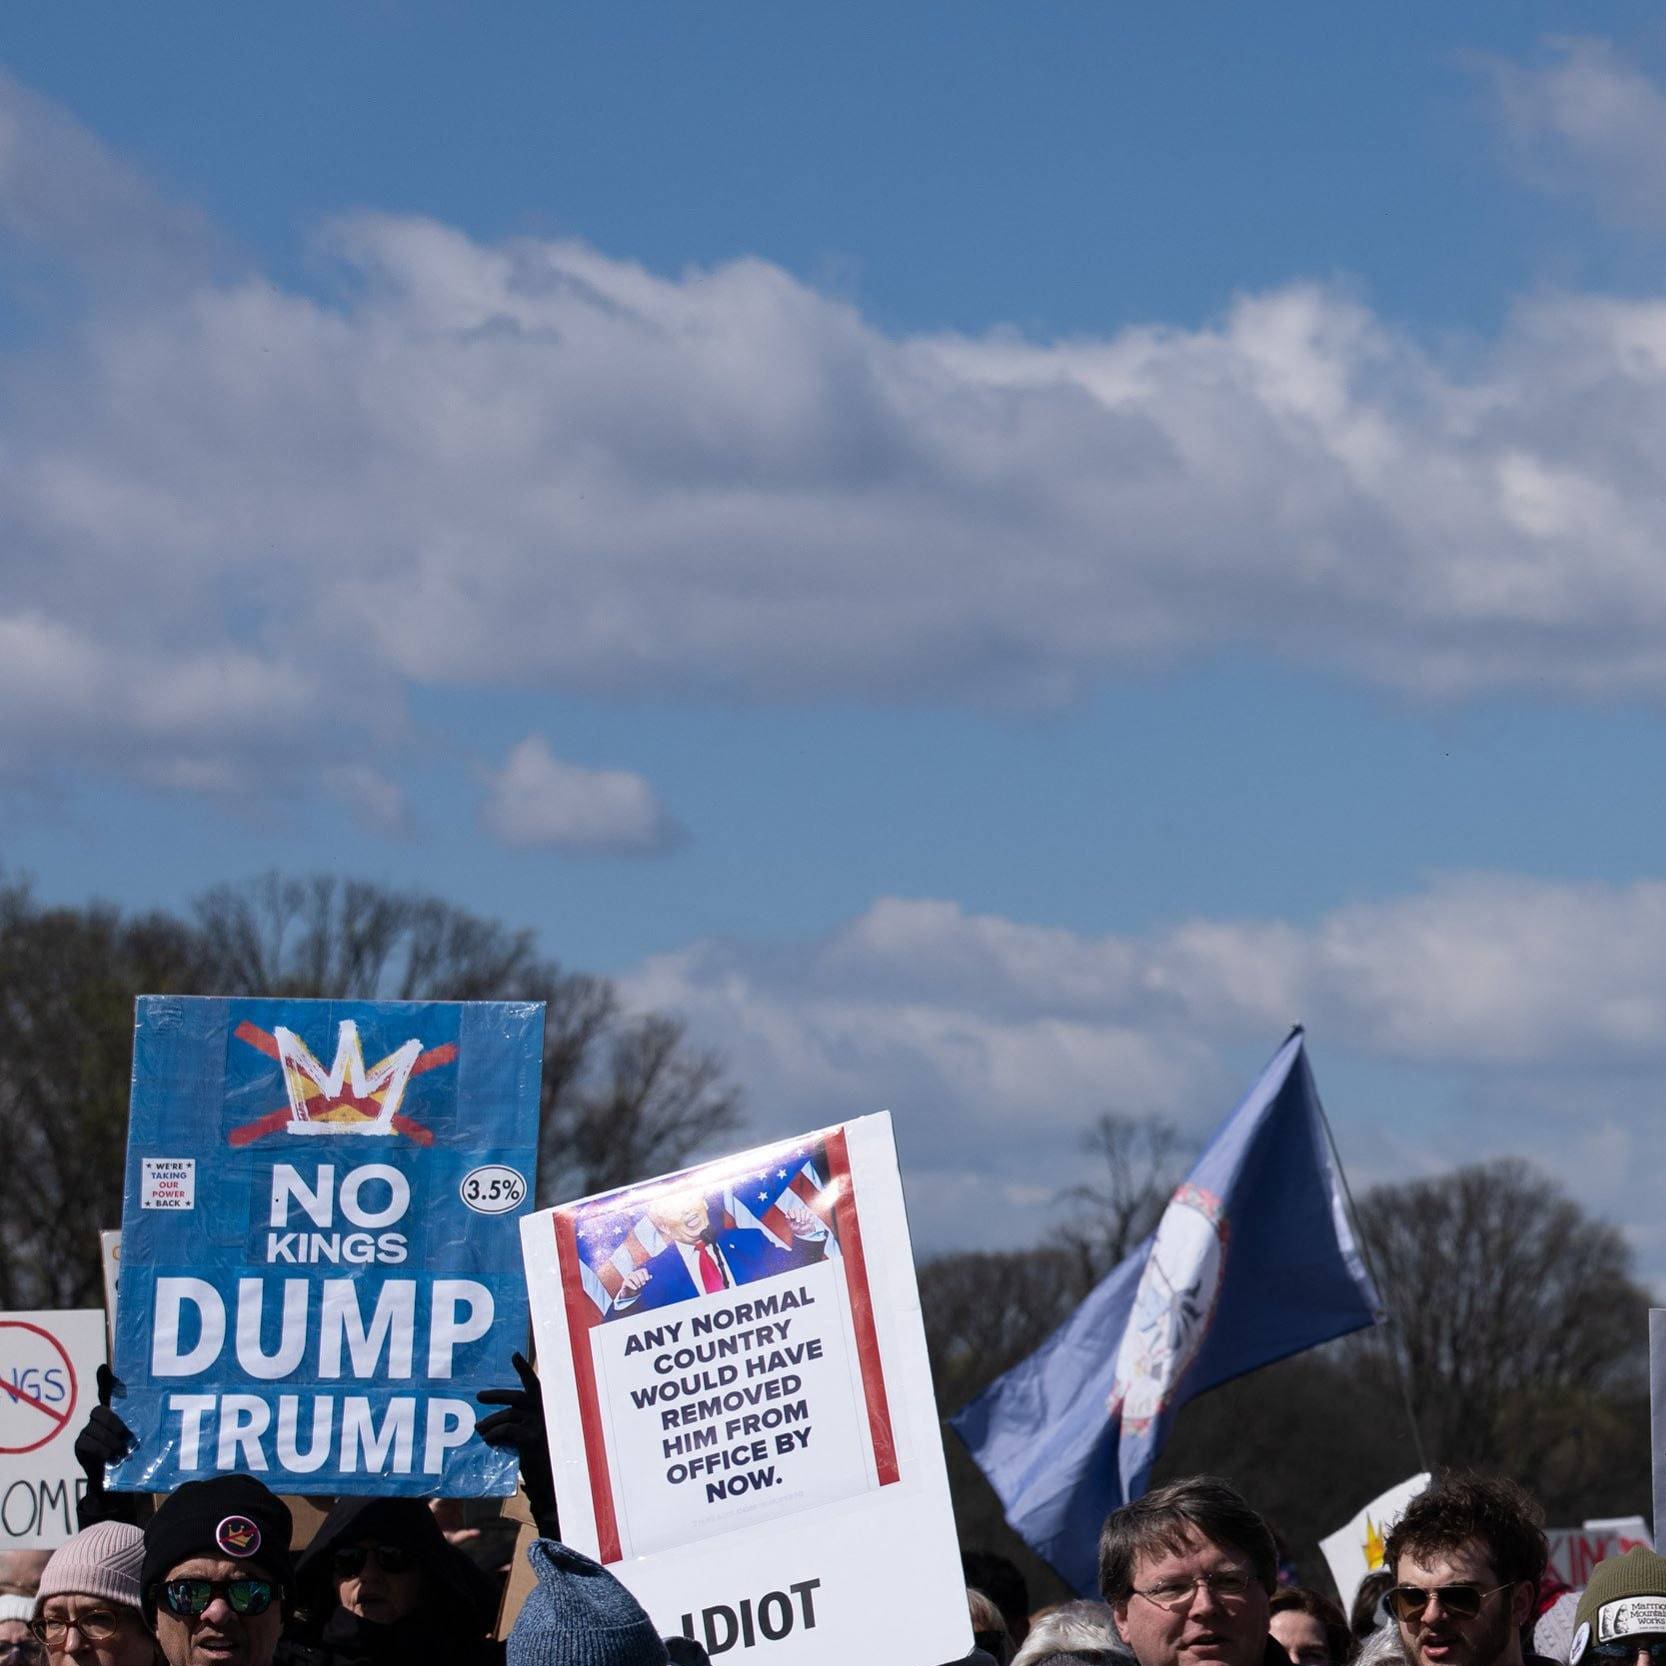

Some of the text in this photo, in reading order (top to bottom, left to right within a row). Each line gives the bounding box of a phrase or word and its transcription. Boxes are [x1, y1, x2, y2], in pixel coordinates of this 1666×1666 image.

[270, 1163, 411, 1229] NO
[467, 1179, 520, 1200] 3.5%
[266, 1233, 408, 1264] KINGS
[151, 1277, 495, 1380] DUMP
[624, 1286, 815, 1356] ANY NORMAL
[654, 1319, 792, 1374] COUNTRY
[631, 1339, 823, 1410] WOULD HAVE
[661, 1374, 801, 1430] REMOVED
[169, 1393, 476, 1474] TRUMP
[662, 1400, 809, 1459] HIM FROM
[667, 1426, 812, 1484] OFFICE BY
[706, 1466, 783, 1503] NOW.
[681, 1578, 820, 1656] IDIOT
